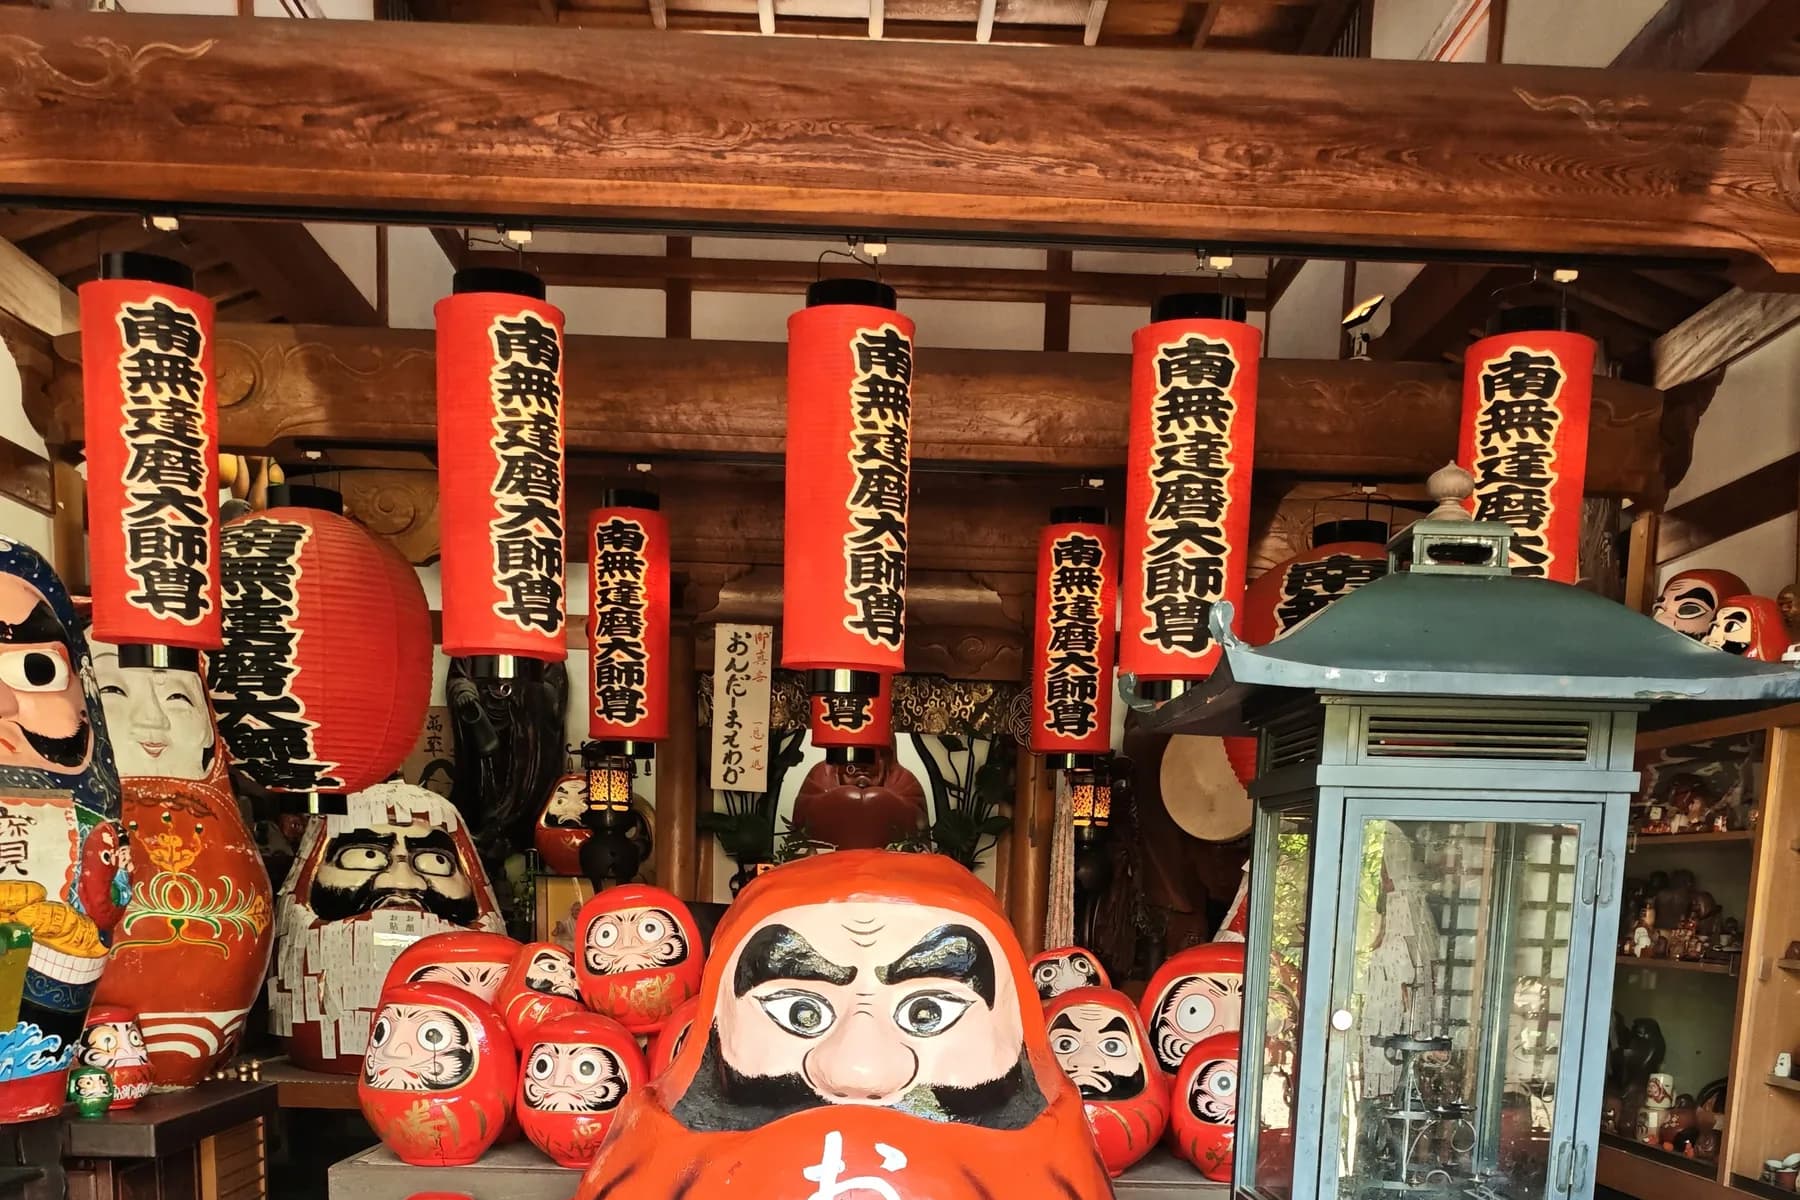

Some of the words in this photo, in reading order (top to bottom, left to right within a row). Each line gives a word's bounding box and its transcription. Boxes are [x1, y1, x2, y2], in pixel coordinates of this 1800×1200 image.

[121, 301, 209, 621] 南無達磨大師尊
[494, 316, 563, 633] 南無達磨大師尊
[848, 329, 911, 646] 南無達磨大師尊
[1143, 337, 1235, 649] 南無達磨大師尊
[596, 519, 646, 723] 南無達磨大師尊
[1045, 535, 1103, 735] 南無達磨大師尊
